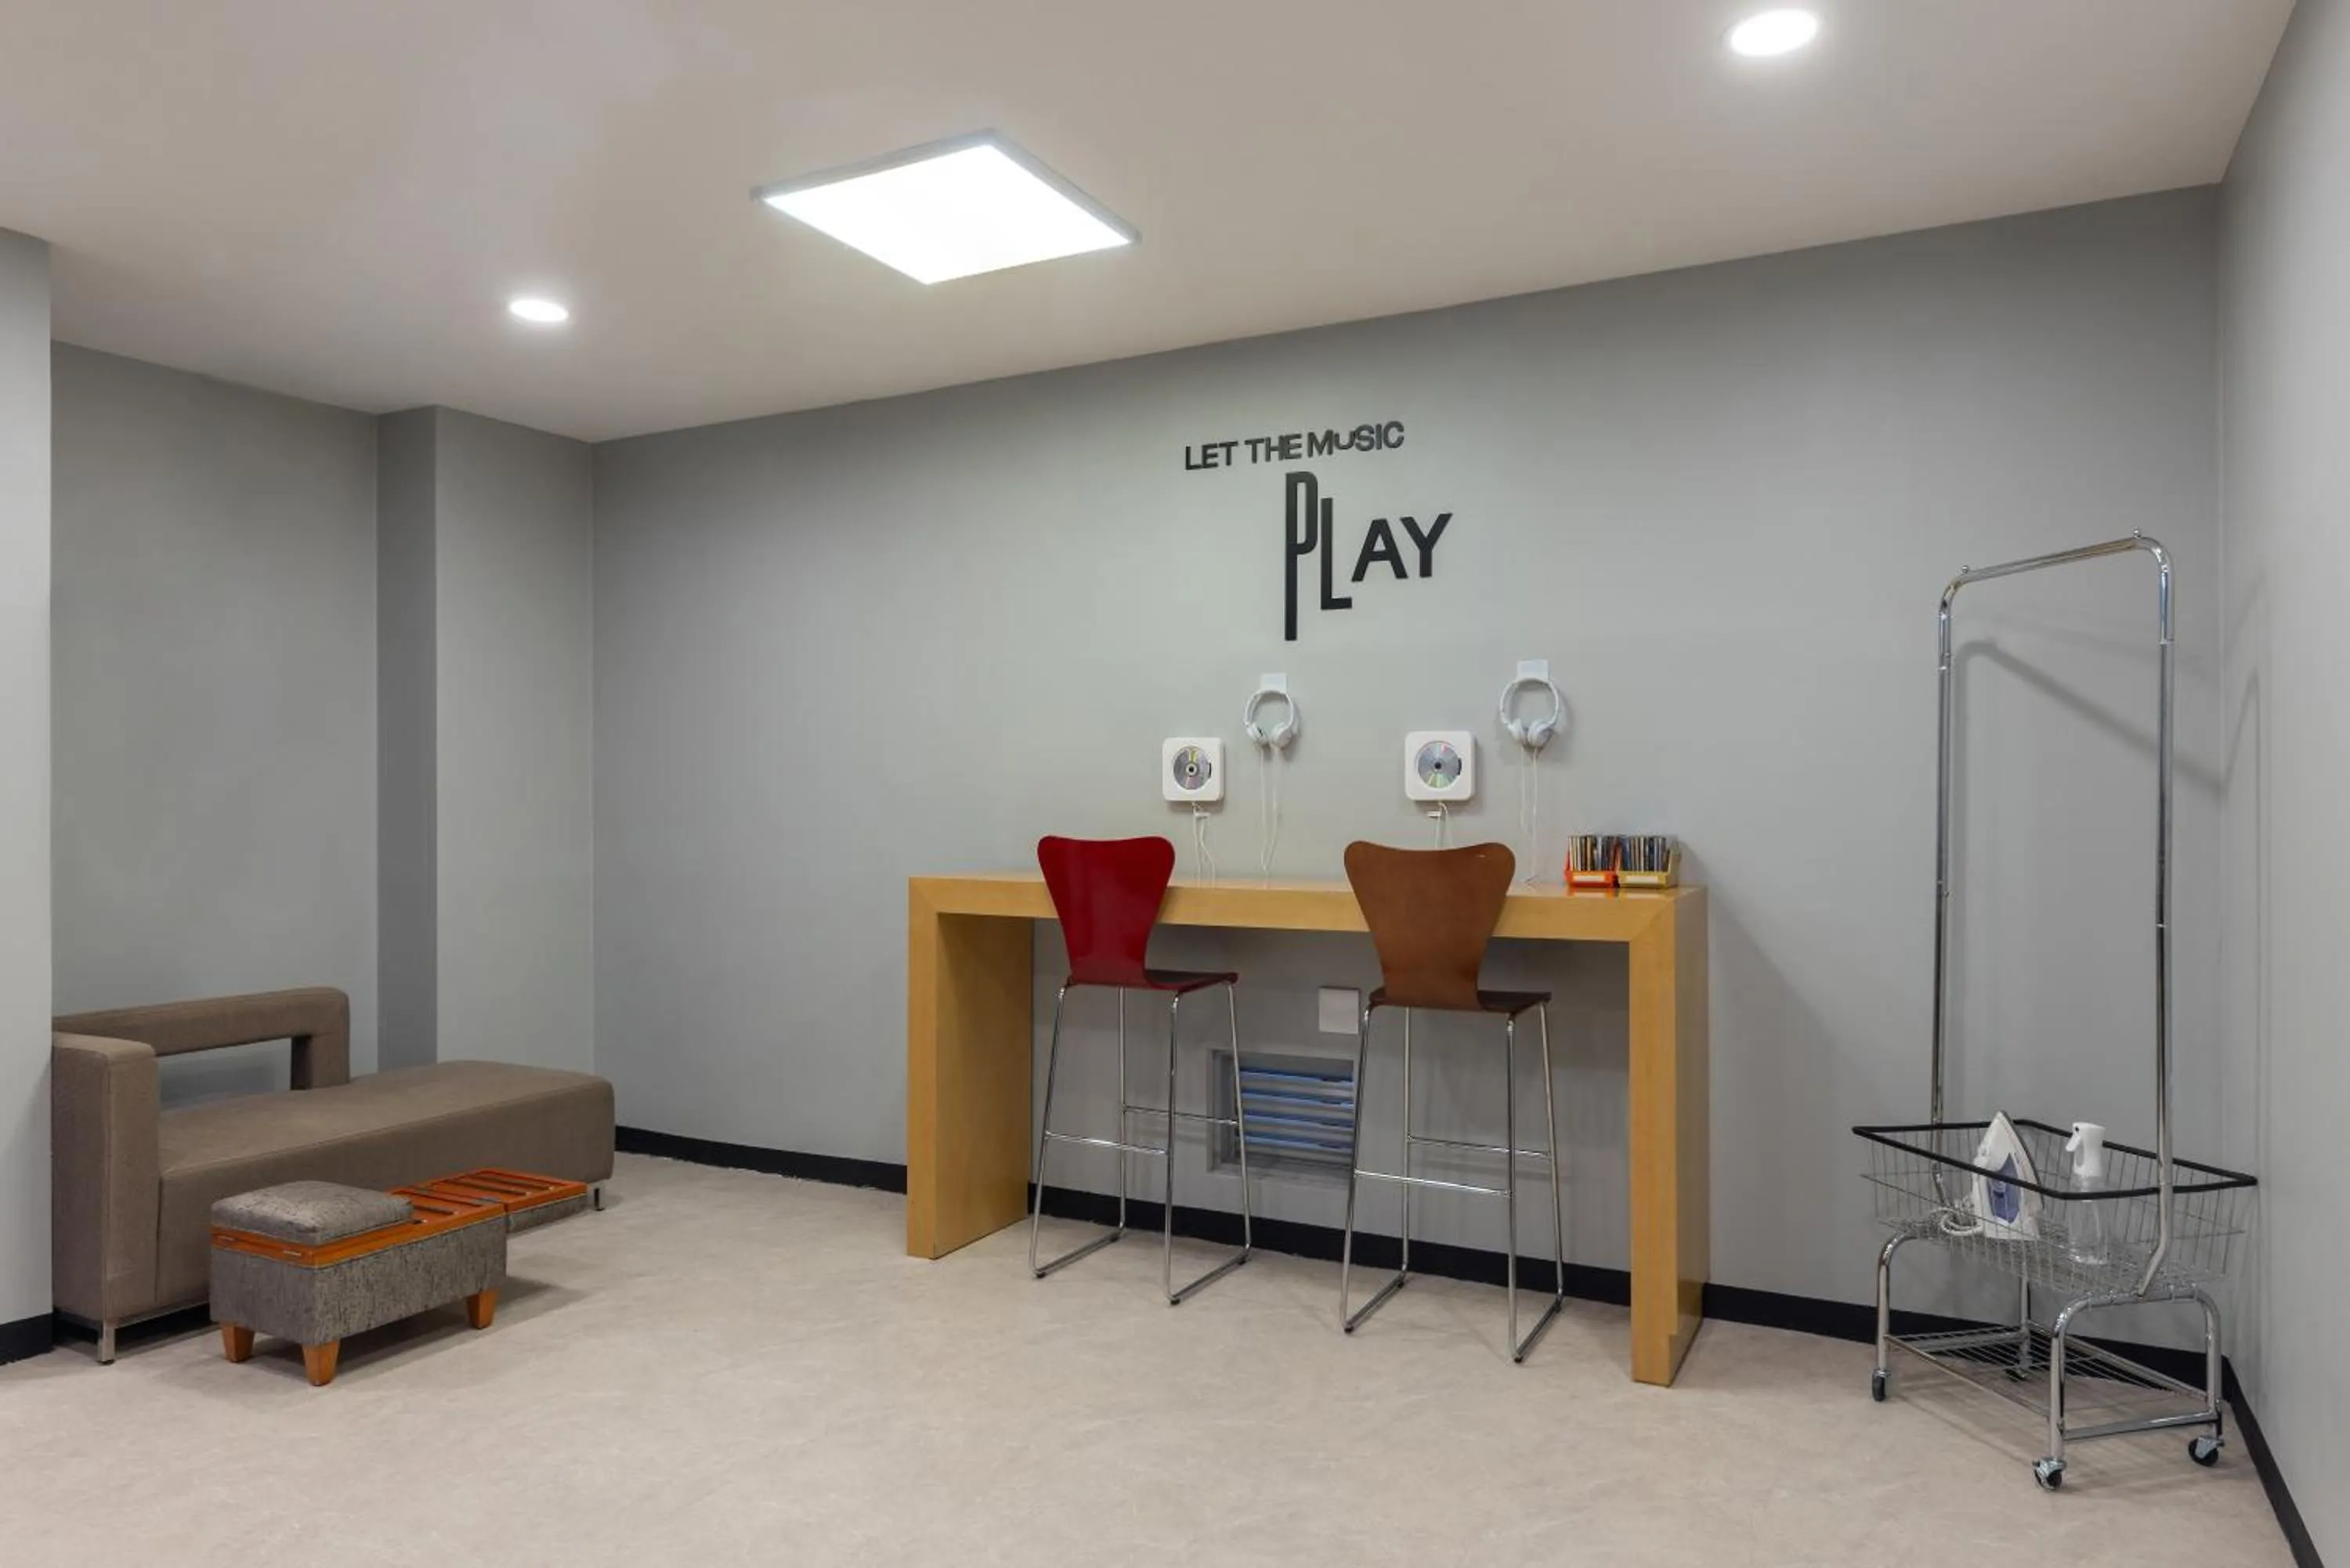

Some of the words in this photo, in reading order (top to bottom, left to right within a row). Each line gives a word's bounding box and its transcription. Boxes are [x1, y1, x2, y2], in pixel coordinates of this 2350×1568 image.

[1185, 441, 1238, 470] LET
[1245, 433, 1302, 464] THE
[1307, 421, 1405, 457] MUSIC
[1285, 471, 1453, 641] PLAY
